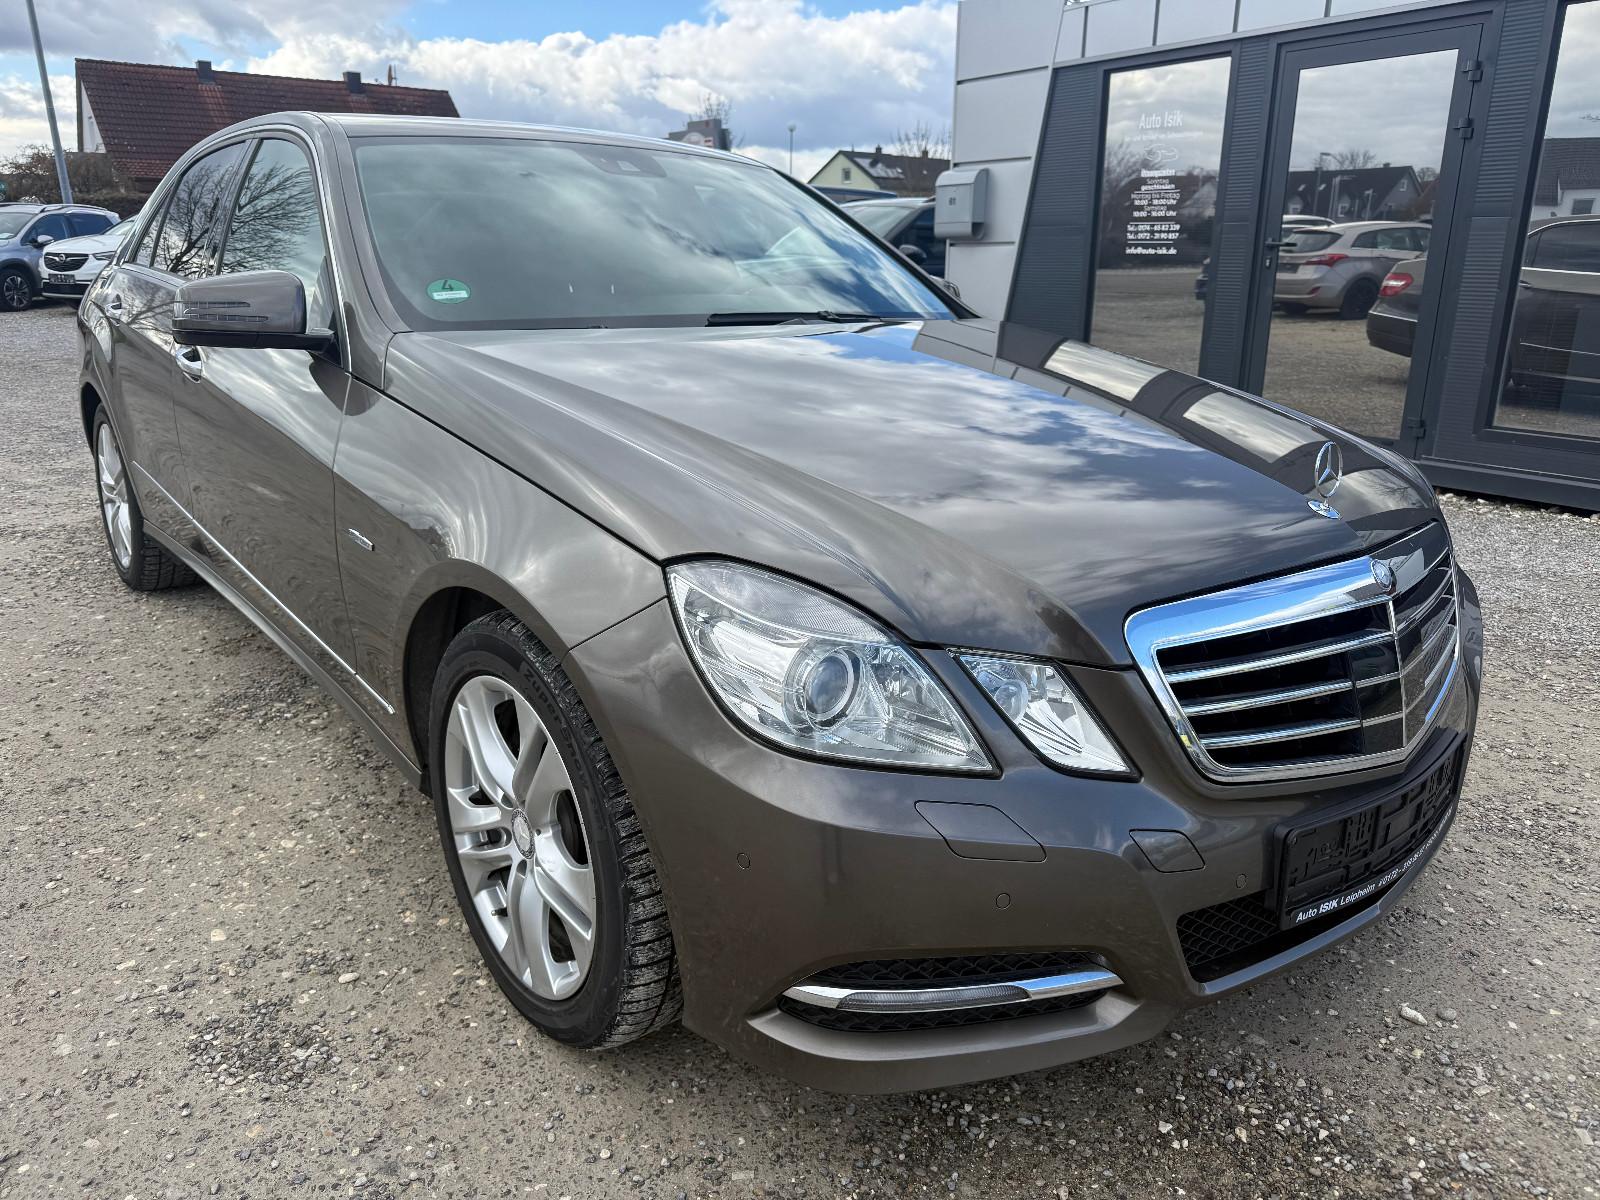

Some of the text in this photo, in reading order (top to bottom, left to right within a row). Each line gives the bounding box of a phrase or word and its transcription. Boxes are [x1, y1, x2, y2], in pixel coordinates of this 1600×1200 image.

[1139, 110, 1183, 129] Auto Isik
[441, 279, 454, 291] 4
[1295, 908, 1318, 923] Auto
[1318, 897, 1340, 914] ISIK
[1339, 883, 1376, 906] Leipheim
